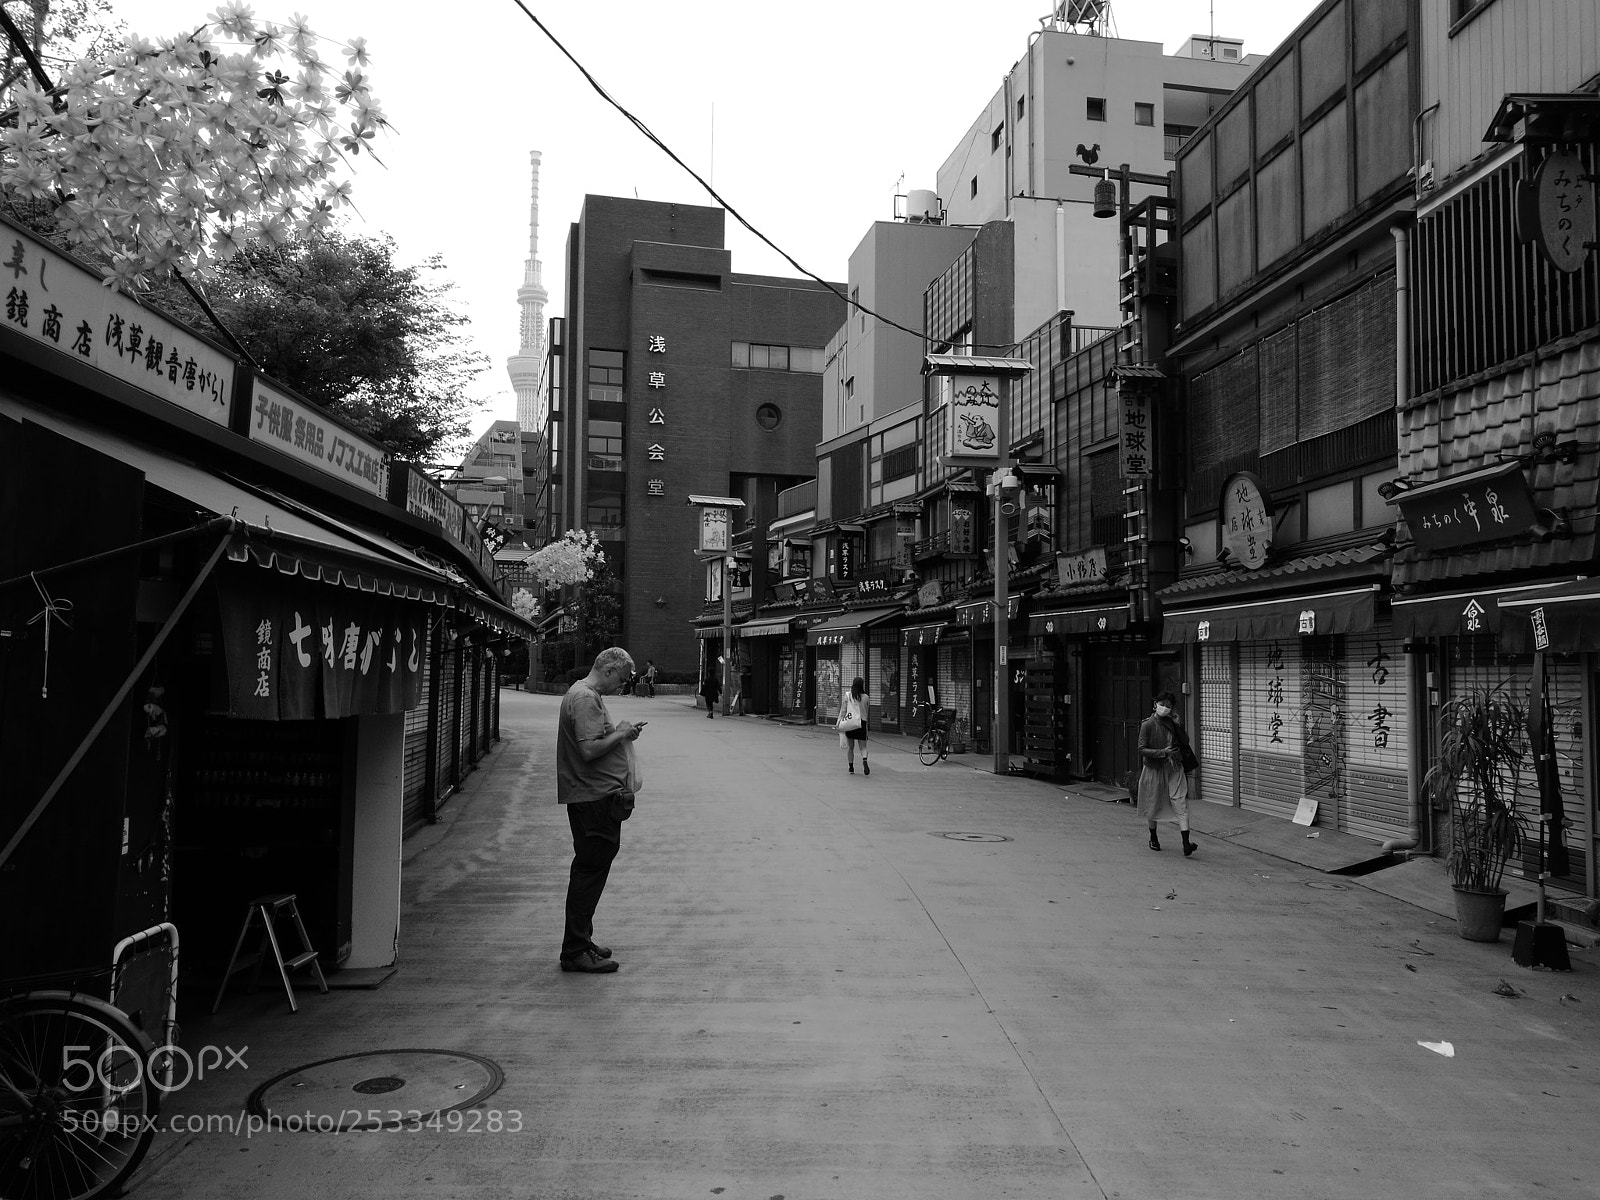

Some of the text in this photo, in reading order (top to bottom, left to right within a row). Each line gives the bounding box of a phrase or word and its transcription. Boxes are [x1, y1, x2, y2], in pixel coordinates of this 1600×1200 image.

[1555, 169, 1571, 256] みちのく
[5, 286, 93, 357] 鏡商店
[105, 313, 225, 406] 浅草観音唐がらし
[255, 394, 293, 443] 子供服
[294, 416, 324, 459] 祭用品
[648, 335, 666, 496] 浅草公会堂
[1125, 409, 1147, 475] 地球堂
[841, 542, 850, 578] 浅草ラスク
[1466, 608, 1481, 631] 泉
[254, 618, 273, 698] 鏡商店
[911, 653, 919, 718] 浅草ラスク
[1267, 640, 1284, 744] 地球堂
[1367, 642, 1393, 751] 古書
